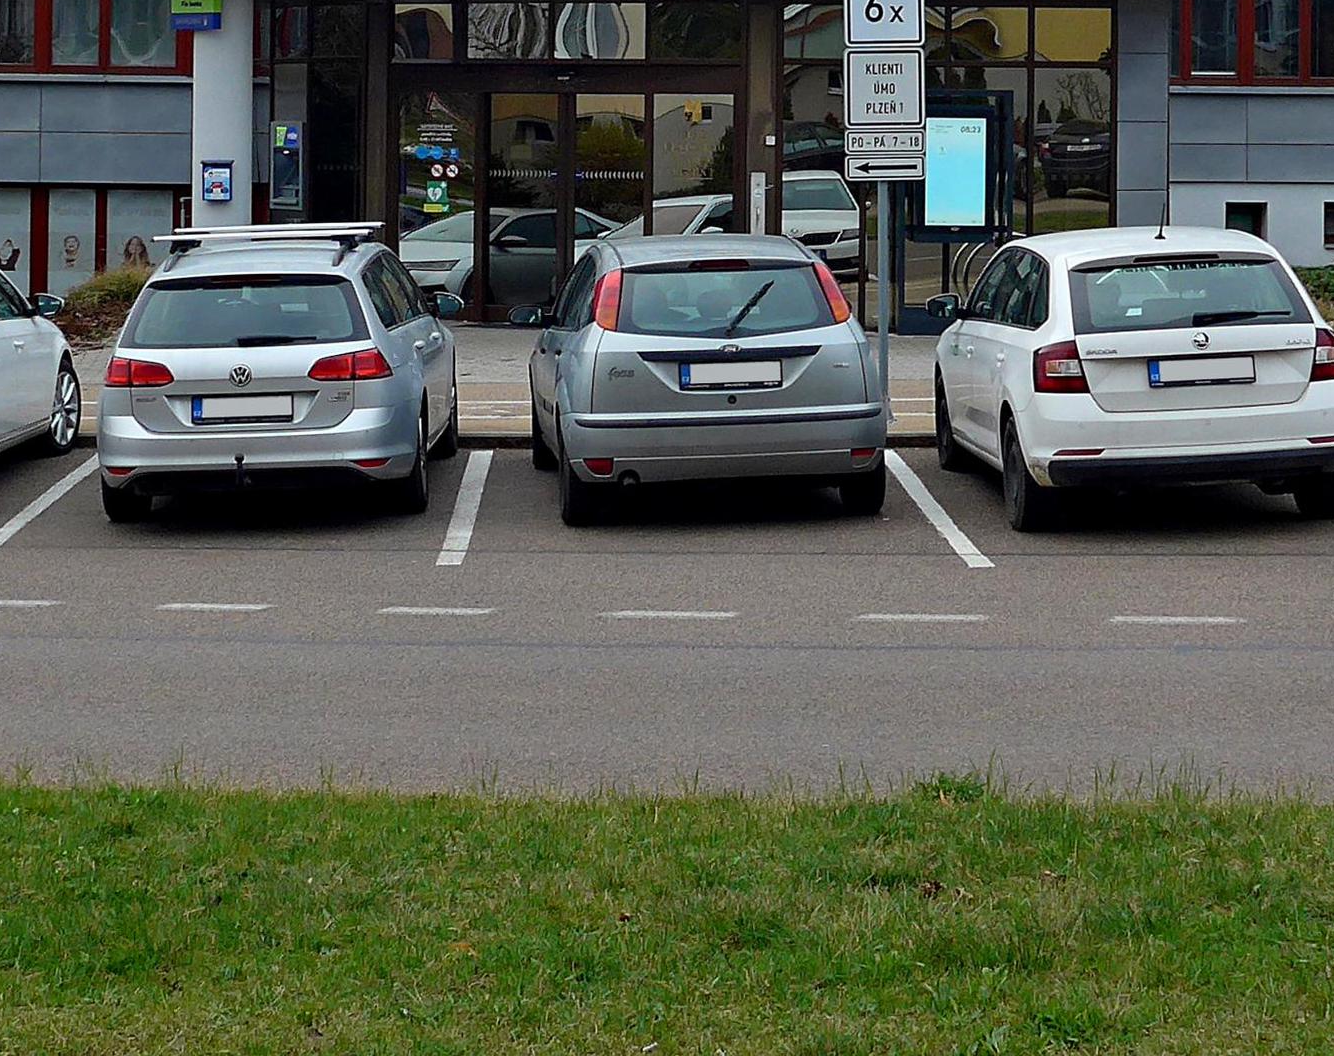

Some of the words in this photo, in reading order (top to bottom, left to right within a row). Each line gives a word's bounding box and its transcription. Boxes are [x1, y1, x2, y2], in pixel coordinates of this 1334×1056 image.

[865, 63, 903, 75] KLIENTI
[873, 80, 896, 95] ÚMO
[866, 100, 896, 114] PLZEŇ
[899, 103, 904, 114] 1
